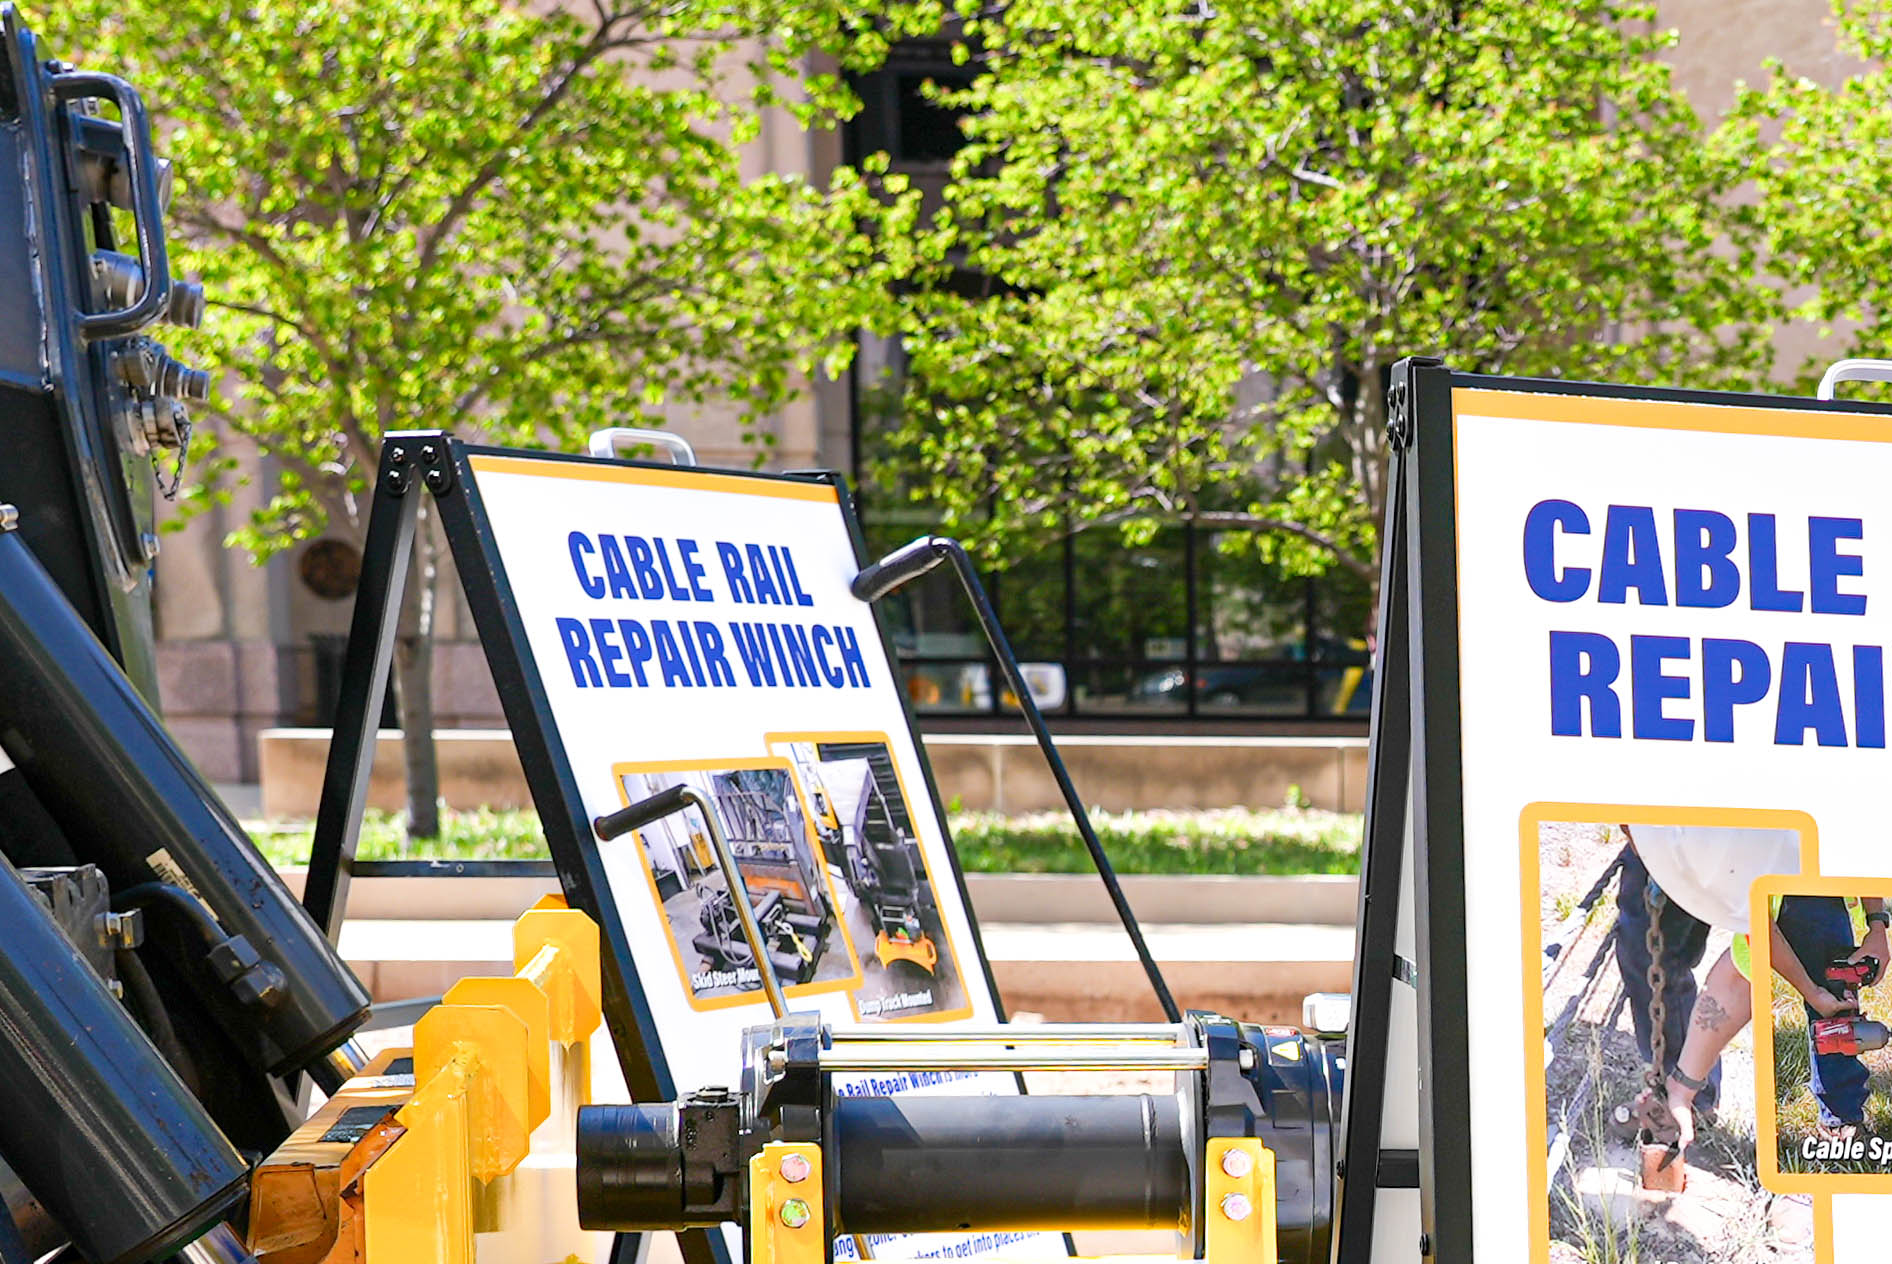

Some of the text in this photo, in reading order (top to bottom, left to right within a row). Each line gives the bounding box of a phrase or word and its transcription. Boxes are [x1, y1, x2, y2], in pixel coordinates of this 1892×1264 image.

[567, 530, 815, 608] CABLE RAIL
[1523, 498, 1868, 617] CABLE
[554, 616, 872, 690] REPAIR WINCH
[692, 970, 713, 990] Skid
[713, 969, 737, 988] Steer
[880, 993, 903, 1012] Truck
[870, 1072, 909, 1097] Repair
[1802, 1136, 1865, 1161] Cable
[972, 1233, 993, 1255] into
